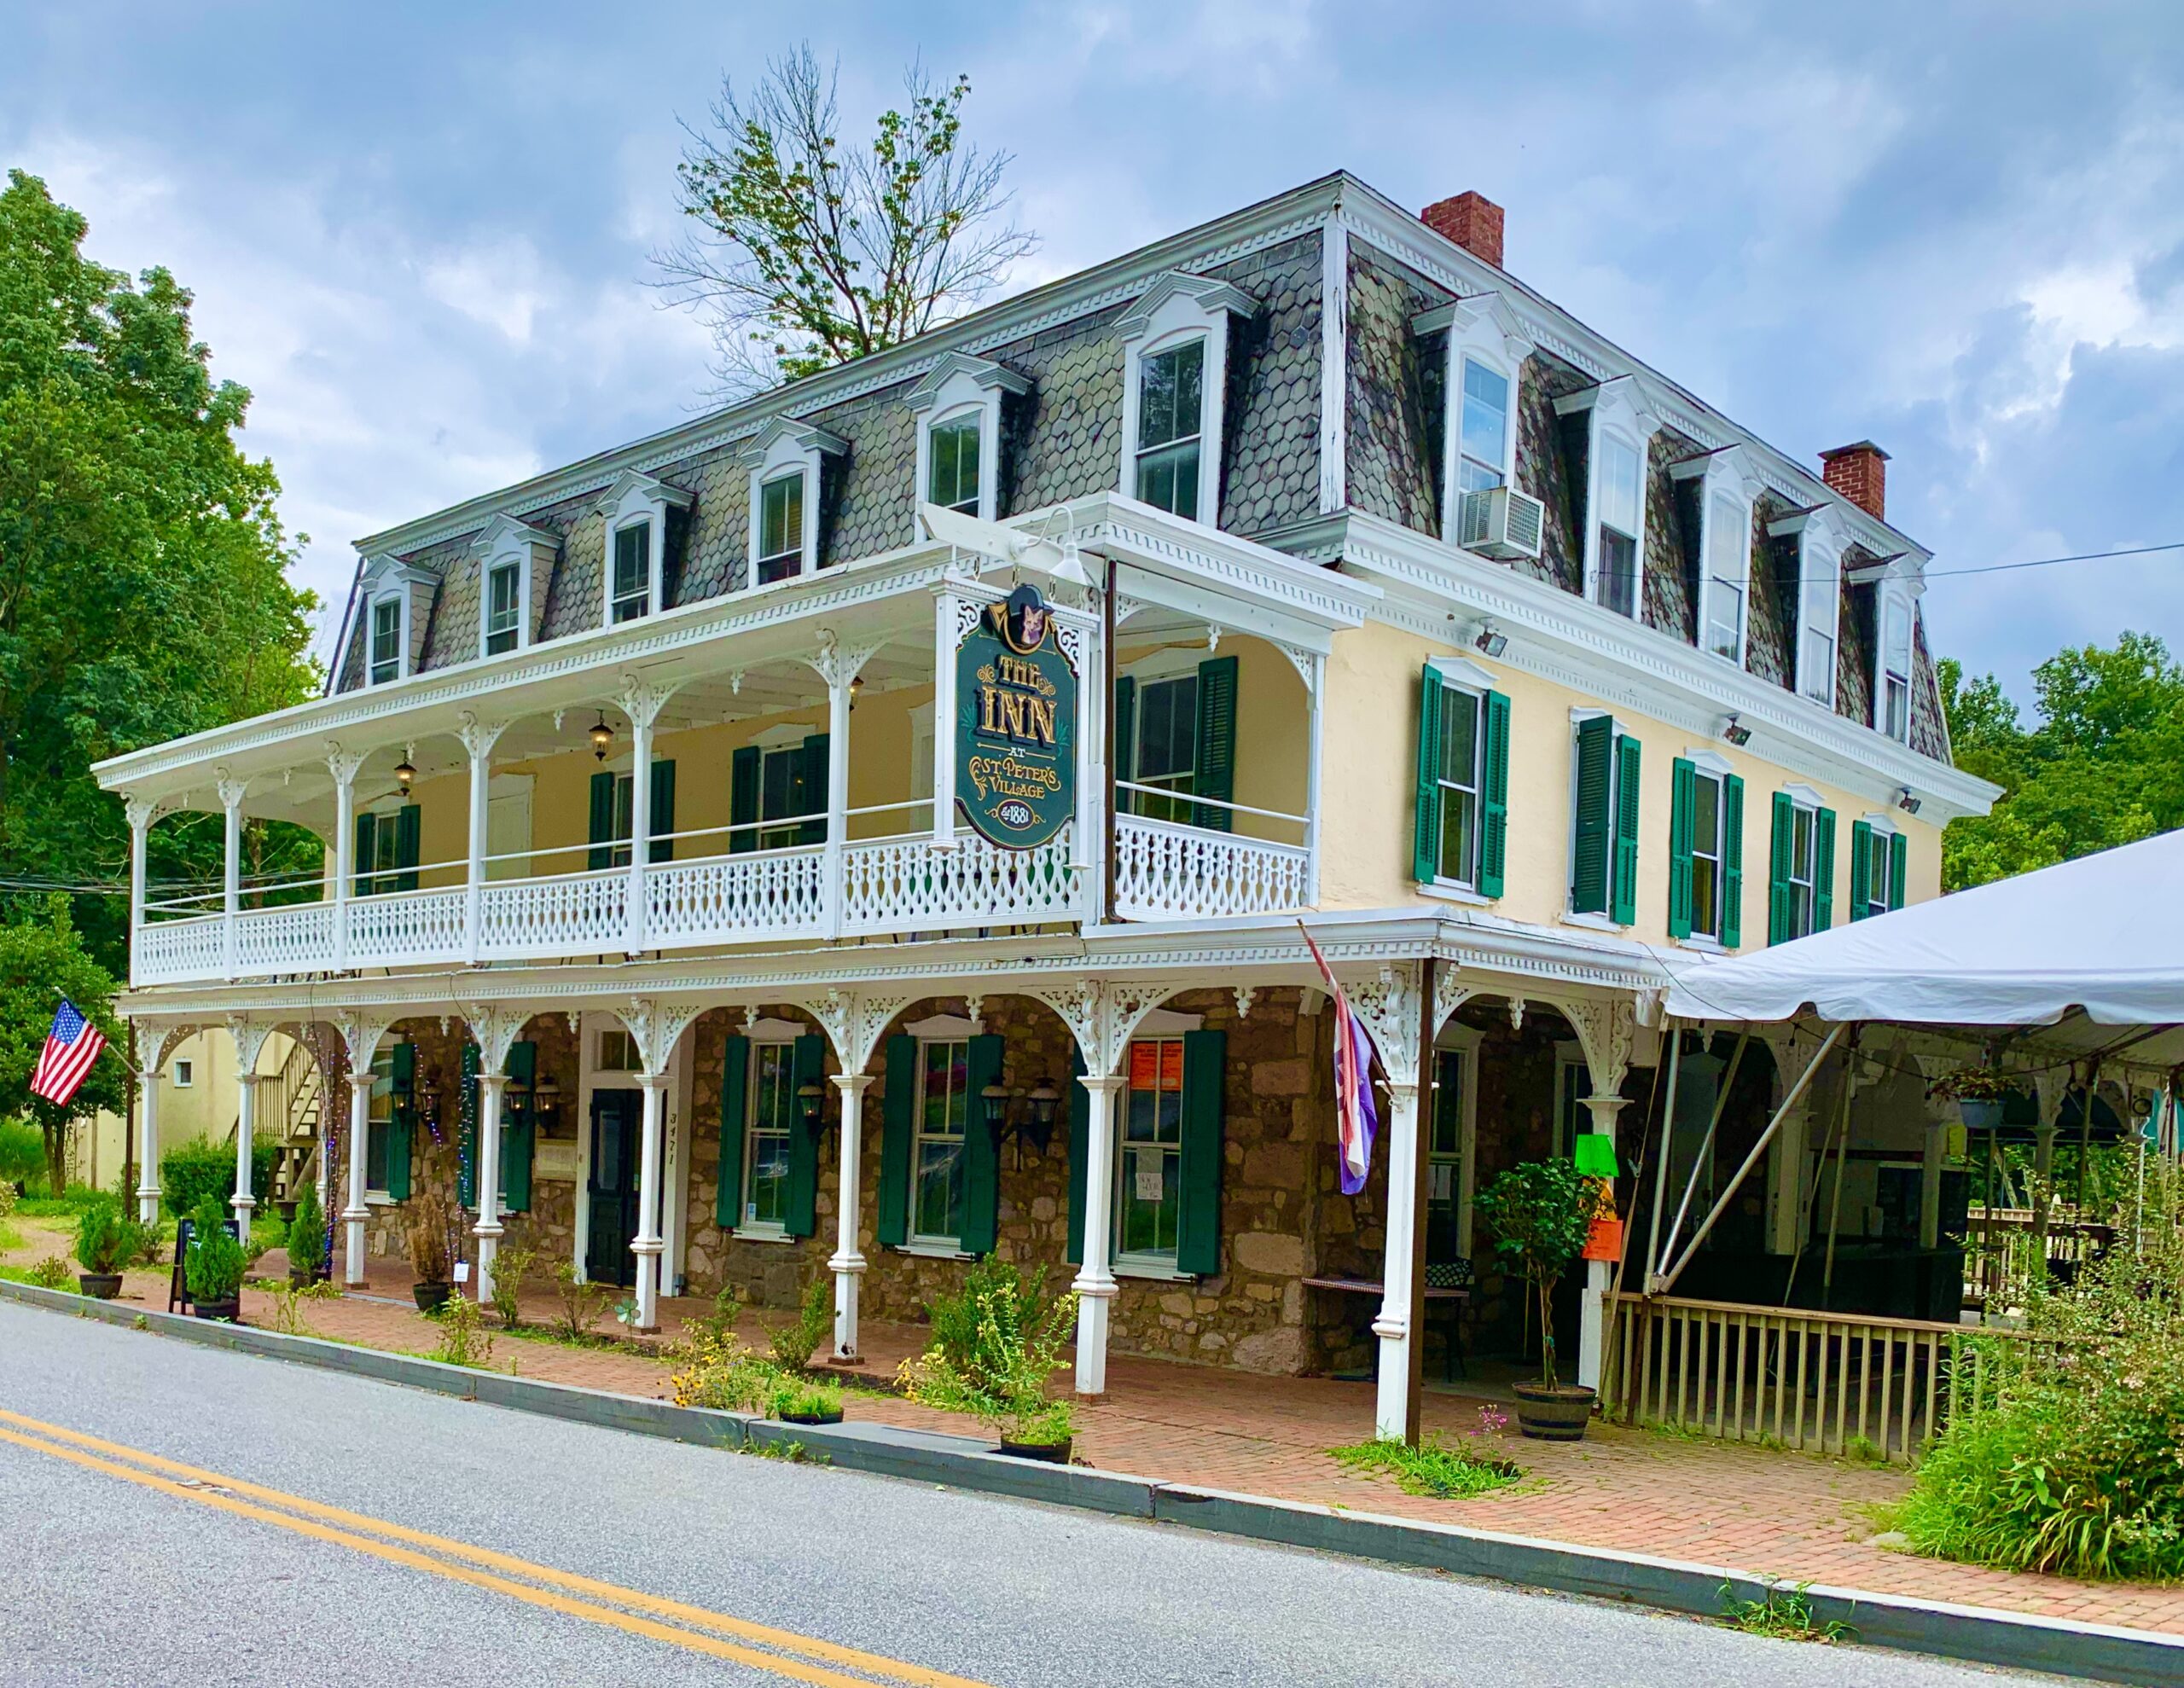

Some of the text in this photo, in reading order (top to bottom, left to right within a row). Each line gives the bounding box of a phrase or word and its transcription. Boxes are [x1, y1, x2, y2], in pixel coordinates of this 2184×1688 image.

[999, 654, 1041, 687] THE
[981, 685, 1057, 744] INN
[1008, 746, 1025, 758] AT
[979, 757, 1060, 792] ST. PETER'S
[988, 775, 1046, 799] VILLAGE
[1010, 805, 1029, 824] 1881
